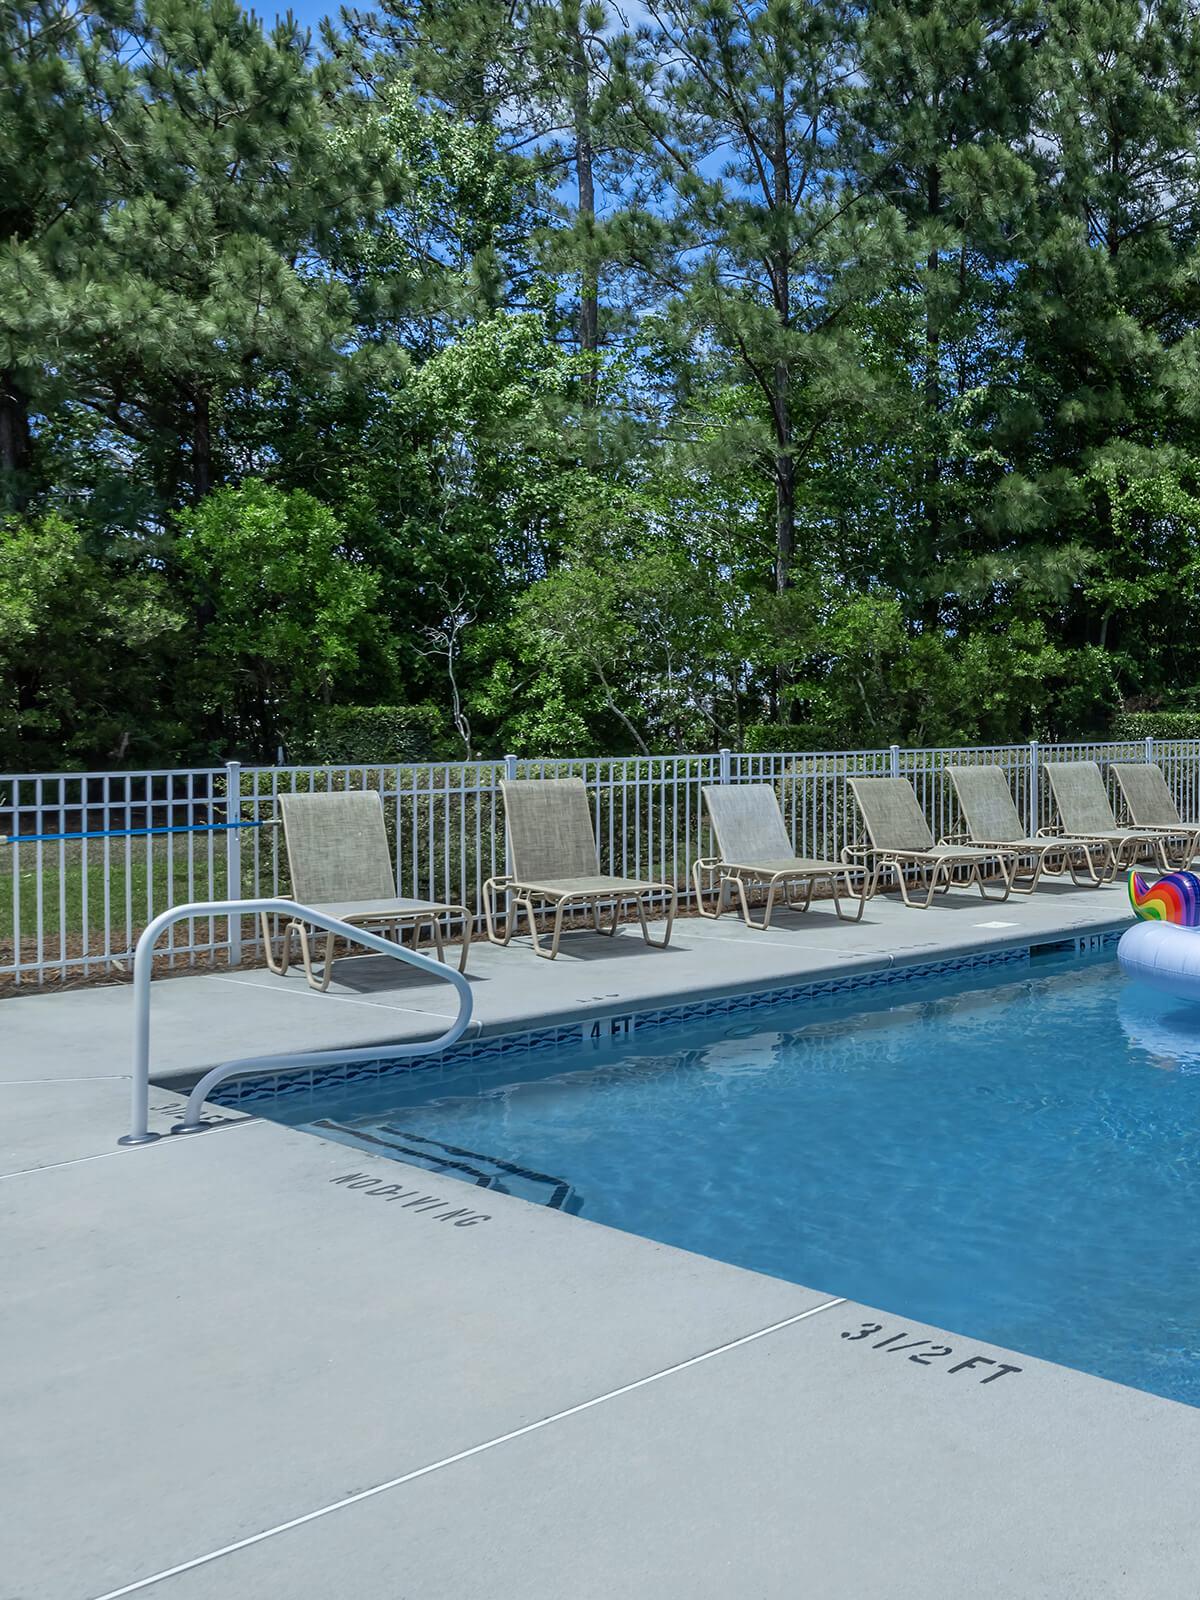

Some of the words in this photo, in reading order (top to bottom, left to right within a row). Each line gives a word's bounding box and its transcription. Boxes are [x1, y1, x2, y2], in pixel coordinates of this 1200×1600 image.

[591, 1019, 602, 1038] 4
[611, 1015, 633, 1035] FT
[946, 1355, 1024, 1385] FT
